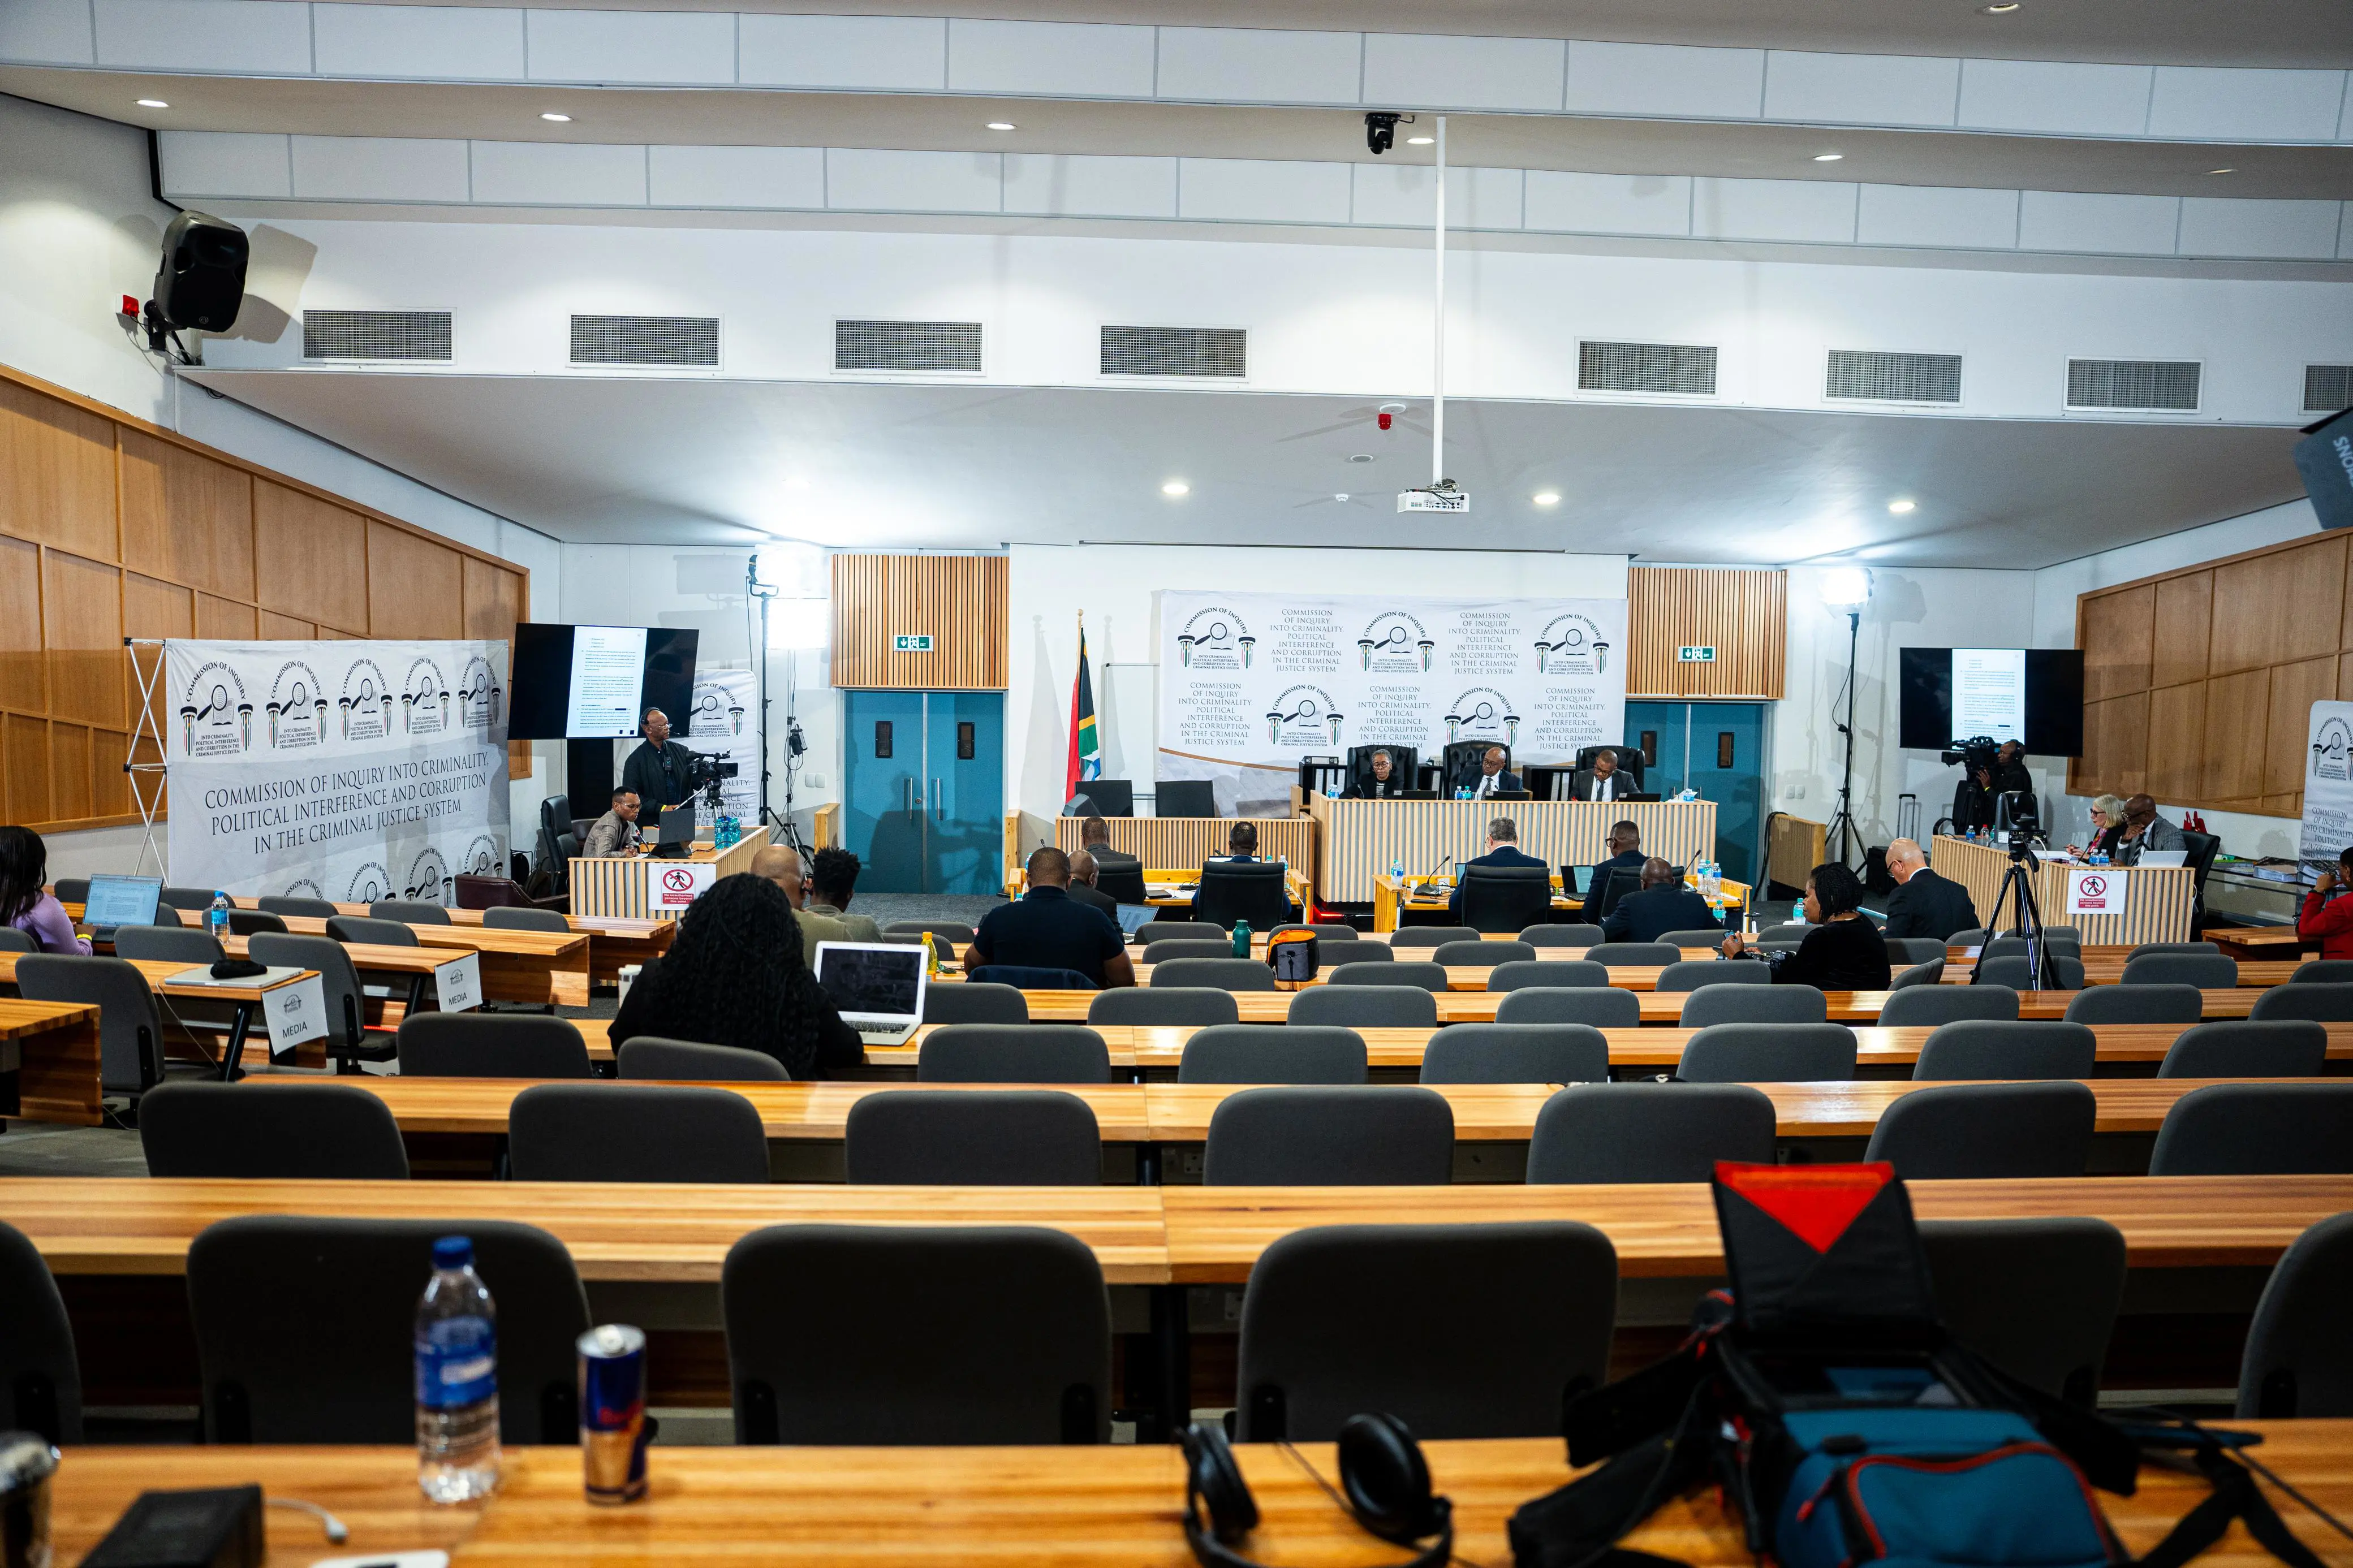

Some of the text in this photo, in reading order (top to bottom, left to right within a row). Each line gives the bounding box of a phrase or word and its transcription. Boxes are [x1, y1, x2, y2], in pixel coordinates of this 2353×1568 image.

[1184, 607, 1217, 632] COMMISSION
[1229, 611, 1247, 634] INQUIRY
[1364, 611, 1397, 637] COMMISSION
[1407, 615, 1427, 638] INQUIRY
[1541, 614, 1572, 639] COMMISSION
[1584, 617, 1601, 640] INQUIRY
[186, 661, 218, 702] COMMISSION
[228, 666, 245, 699] INQUIRY
[272, 660, 296, 698] COMMISSION
[305, 664, 321, 695] INQUIRY
[343, 658, 364, 694] COMMISSION
[372, 663, 386, 691] INQUIRY
[405, 657, 425, 690] COMMISSION
[432, 662, 444, 688] INQUIRY
[718, 685, 736, 705] INQUIRY
[1273, 685, 1305, 710] COMMISSION
[1317, 688, 1335, 711] INQUIRY
[1451, 687, 1483, 712] COMMISSION
[1494, 690, 1512, 713] INQUIRY
[205, 752, 489, 809] COMMISSION OF INQUIRY INTO CRIMINALITY,
[212, 772, 486, 835] POLITICAL INTERFERENCE AND CORRUPTION
[2312, 807, 2348, 819] COMMISSION
[255, 798, 462, 854] IN THE CRIMINAL JUSTICE SYSTEM
[2304, 823, 2317, 832] INTO
[2322, 818, 2346, 828] INQUIRY
[464, 835, 482, 869] COMMISSION
[488, 837, 499, 860] INQUIRY
[2315, 835, 2342, 846] POLITICAL
[409, 848, 429, 884] COMMISSION
[436, 850, 448, 875] INQUIRY
[283, 879, 302, 897] ISSION
[311, 882, 324, 900] INQUI
[348, 862, 370, 902] COMMISSION
[377, 864, 390, 890] INQUIRY
[449, 992, 467, 1006] MEDIA
[283, 1021, 307, 1039] MEDIA
